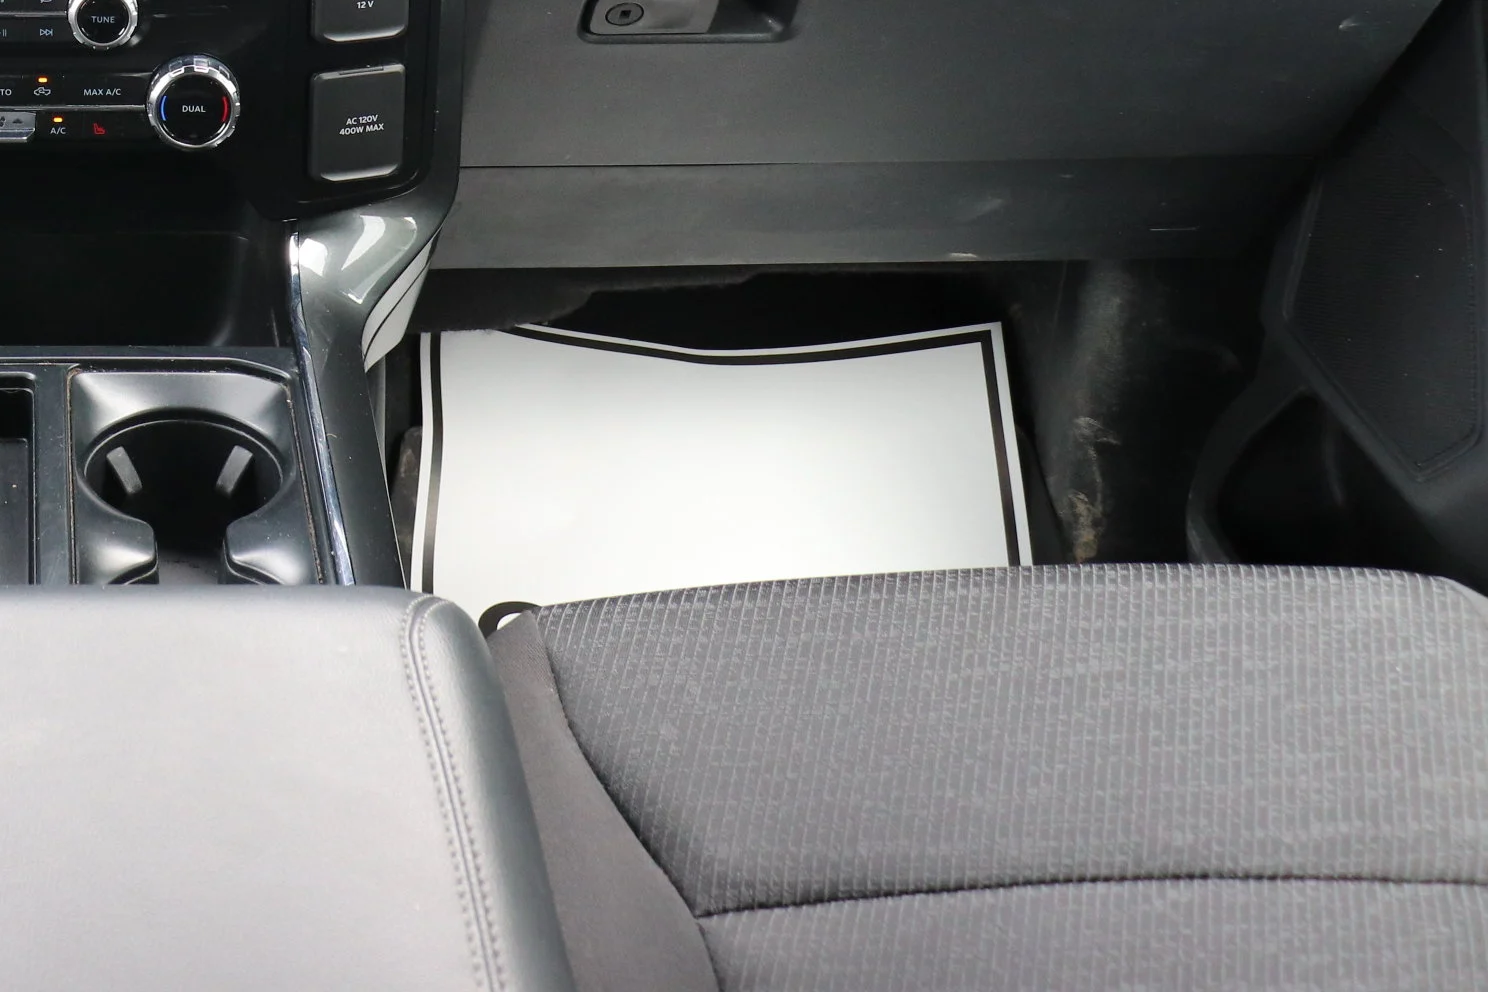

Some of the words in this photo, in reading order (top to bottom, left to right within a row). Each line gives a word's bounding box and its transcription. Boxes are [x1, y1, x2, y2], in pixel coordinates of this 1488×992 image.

[356, 1, 366, 9] 12
[367, 0, 374, 8] V
[91, 16, 115, 24] TUNE
[84, 88, 104, 96] MAX
[106, 88, 122, 96] A/C
[182, 105, 206, 114] DUAL
[346, 116, 358, 126] AC
[358, 114, 379, 124] 120V
[50, 126, 66, 135] A/C
[339, 125, 364, 136] 400W
[366, 123, 385, 133] MAX
